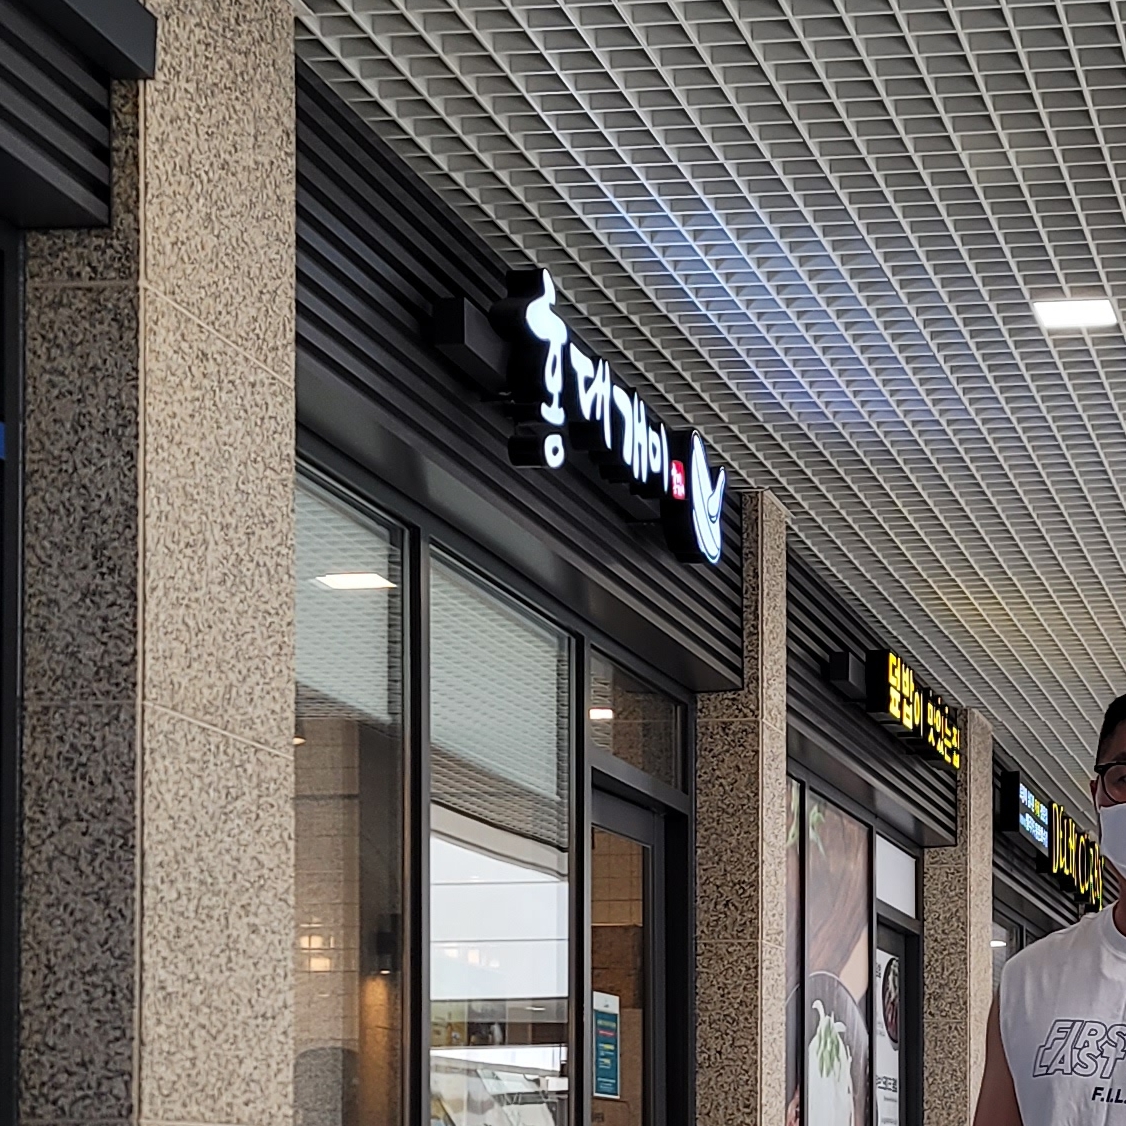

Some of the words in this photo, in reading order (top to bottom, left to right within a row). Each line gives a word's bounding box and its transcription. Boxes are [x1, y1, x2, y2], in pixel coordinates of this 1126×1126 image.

[888, 652, 924, 737] 덮밥이
[926, 689, 961, 770] 맛있는집
[1032, 1041, 1126, 1080] LAST
